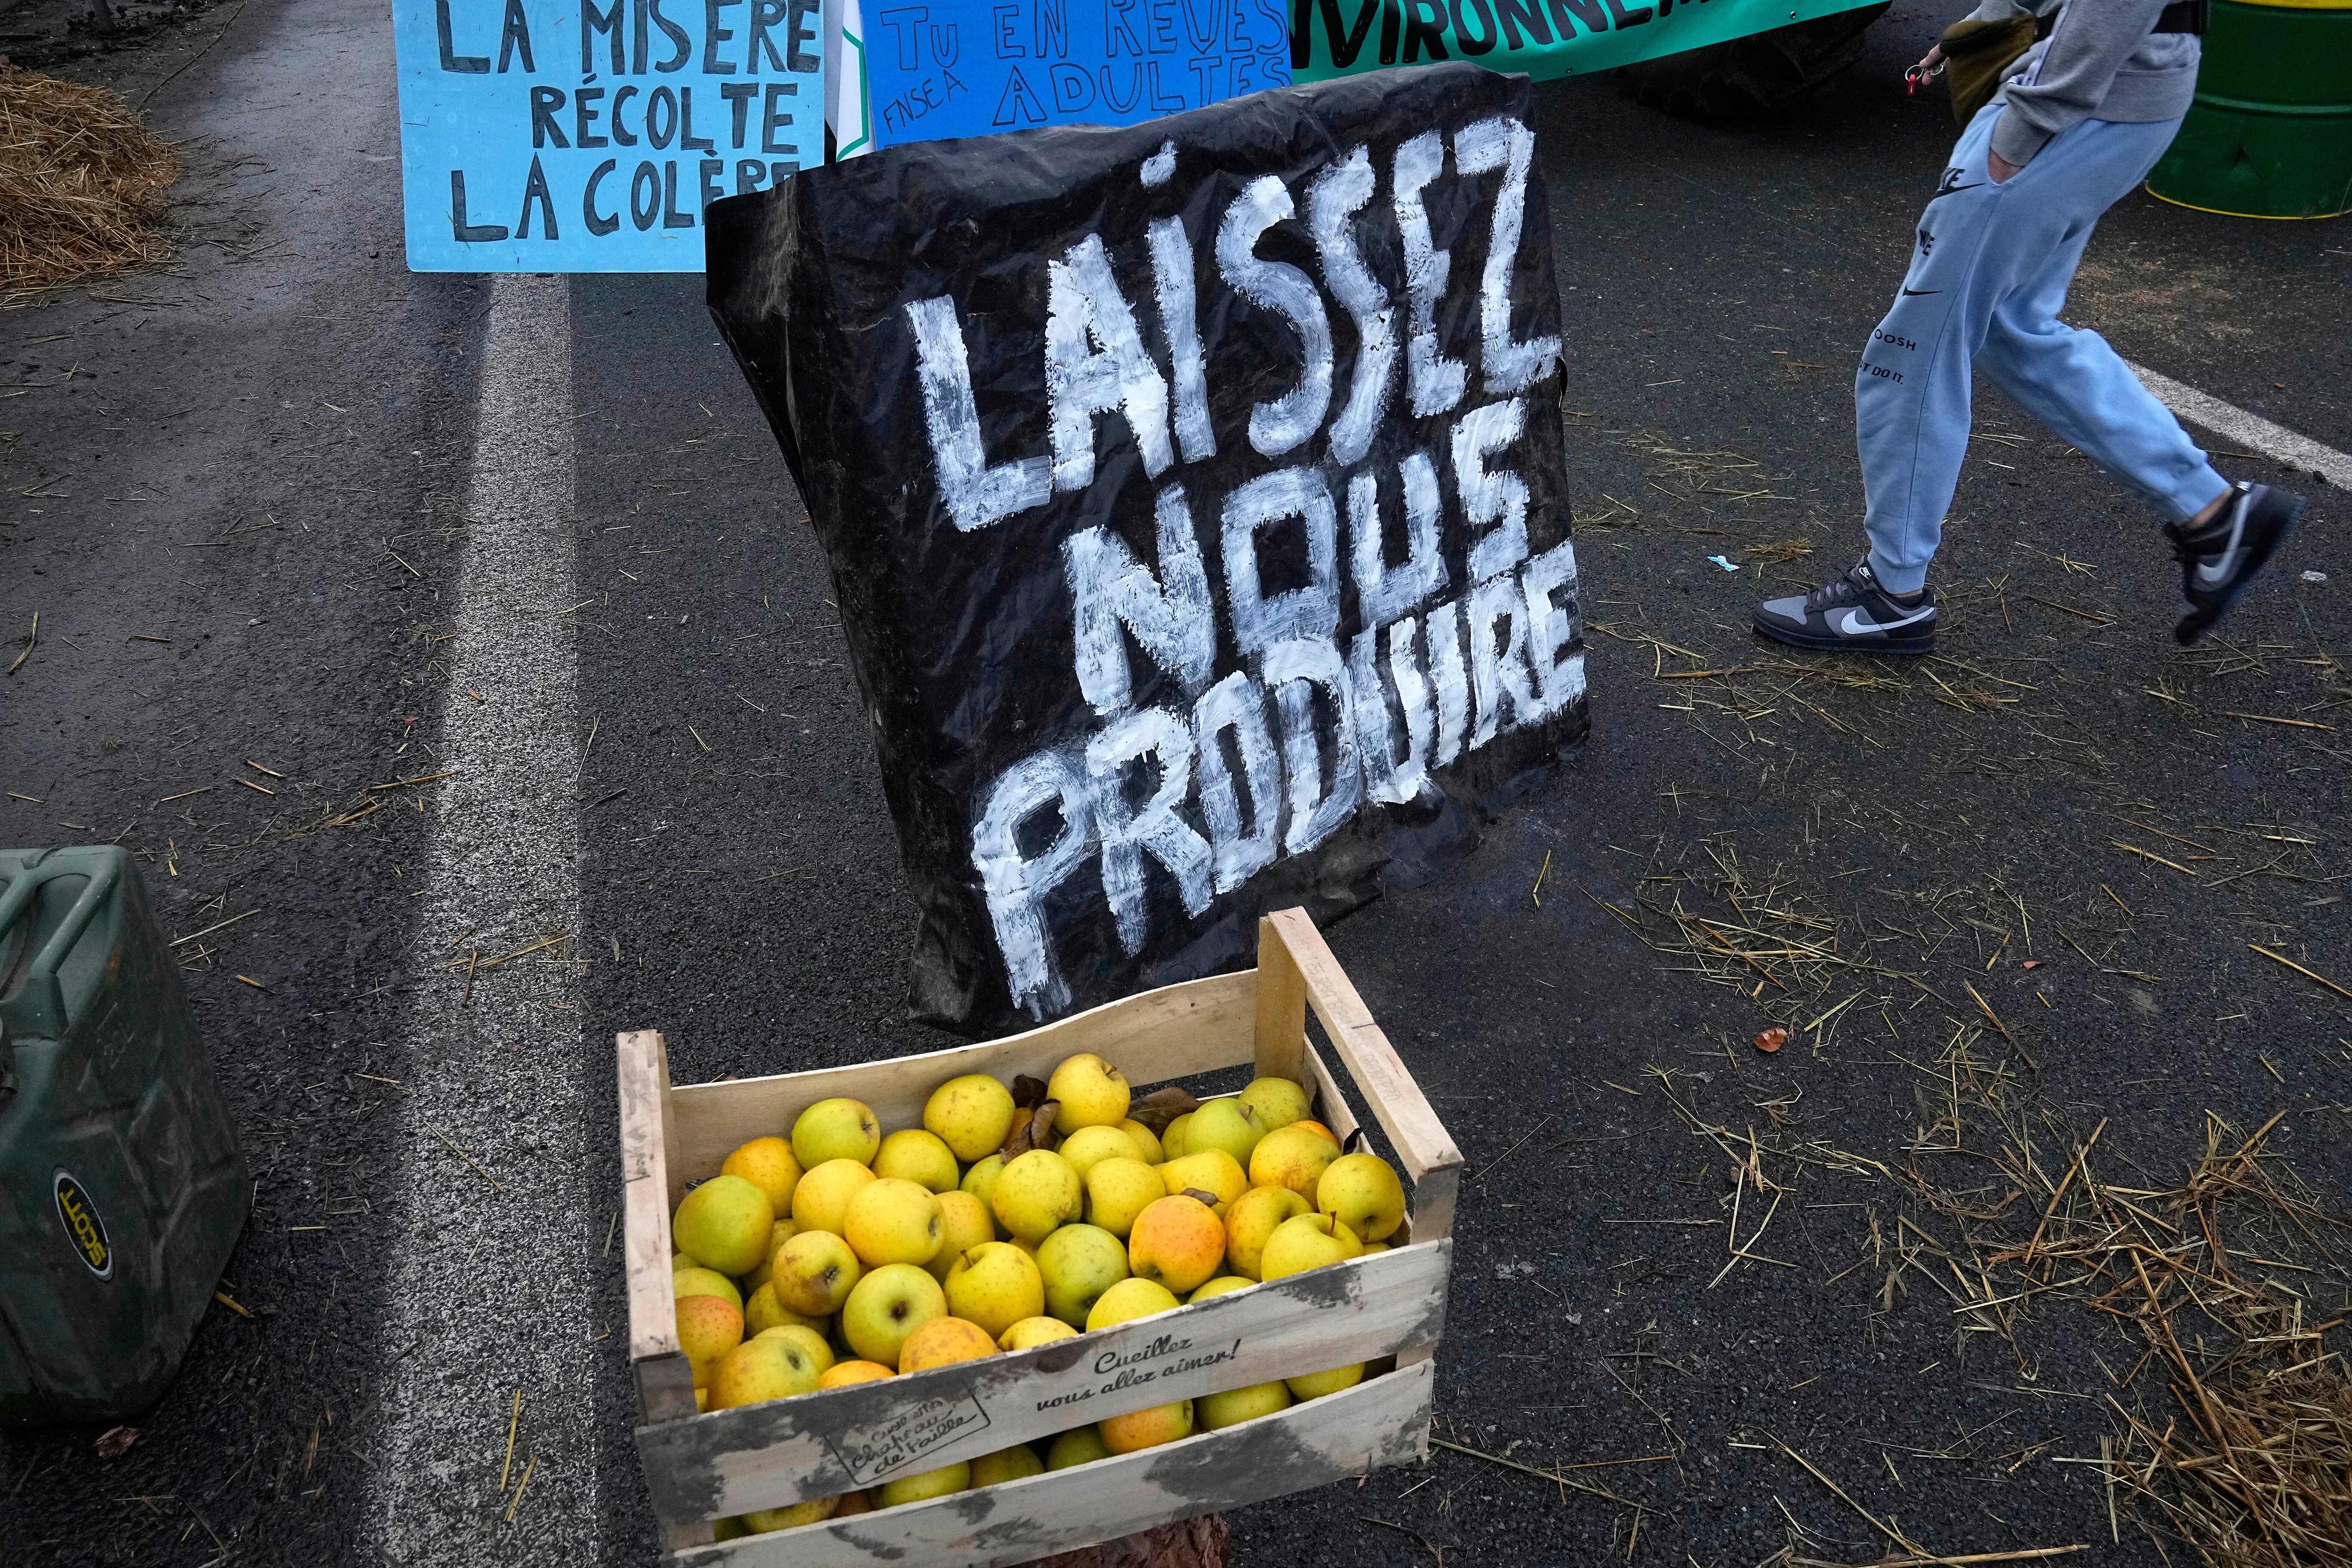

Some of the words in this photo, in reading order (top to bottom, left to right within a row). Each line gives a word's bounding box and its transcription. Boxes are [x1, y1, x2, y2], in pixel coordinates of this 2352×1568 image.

[436, 0, 536, 74] LA
[880, 6, 959, 71] TU
[993, 0, 1067, 58] EN
[530, 73, 798, 154] RÉCOLTE
[883, 69, 968, 135] FNSEA
[992, 55, 1293, 127] ADULTES
[451, 152, 559, 242] LA
[1871, 366, 1891, 379] DO
[1059, 397, 1531, 716] NOUS
[972, 540, 1587, 1022] PRODUIRE
[59, 1188, 107, 1266] SCOTT
[1036, 1388, 1096, 1411] vous
[1100, 1368, 1157, 1394] allez
[1162, 1338, 1242, 1377] aimer!
[1094, 1334, 1193, 1374] Cueillez
[874, 1453, 906, 1474] de
